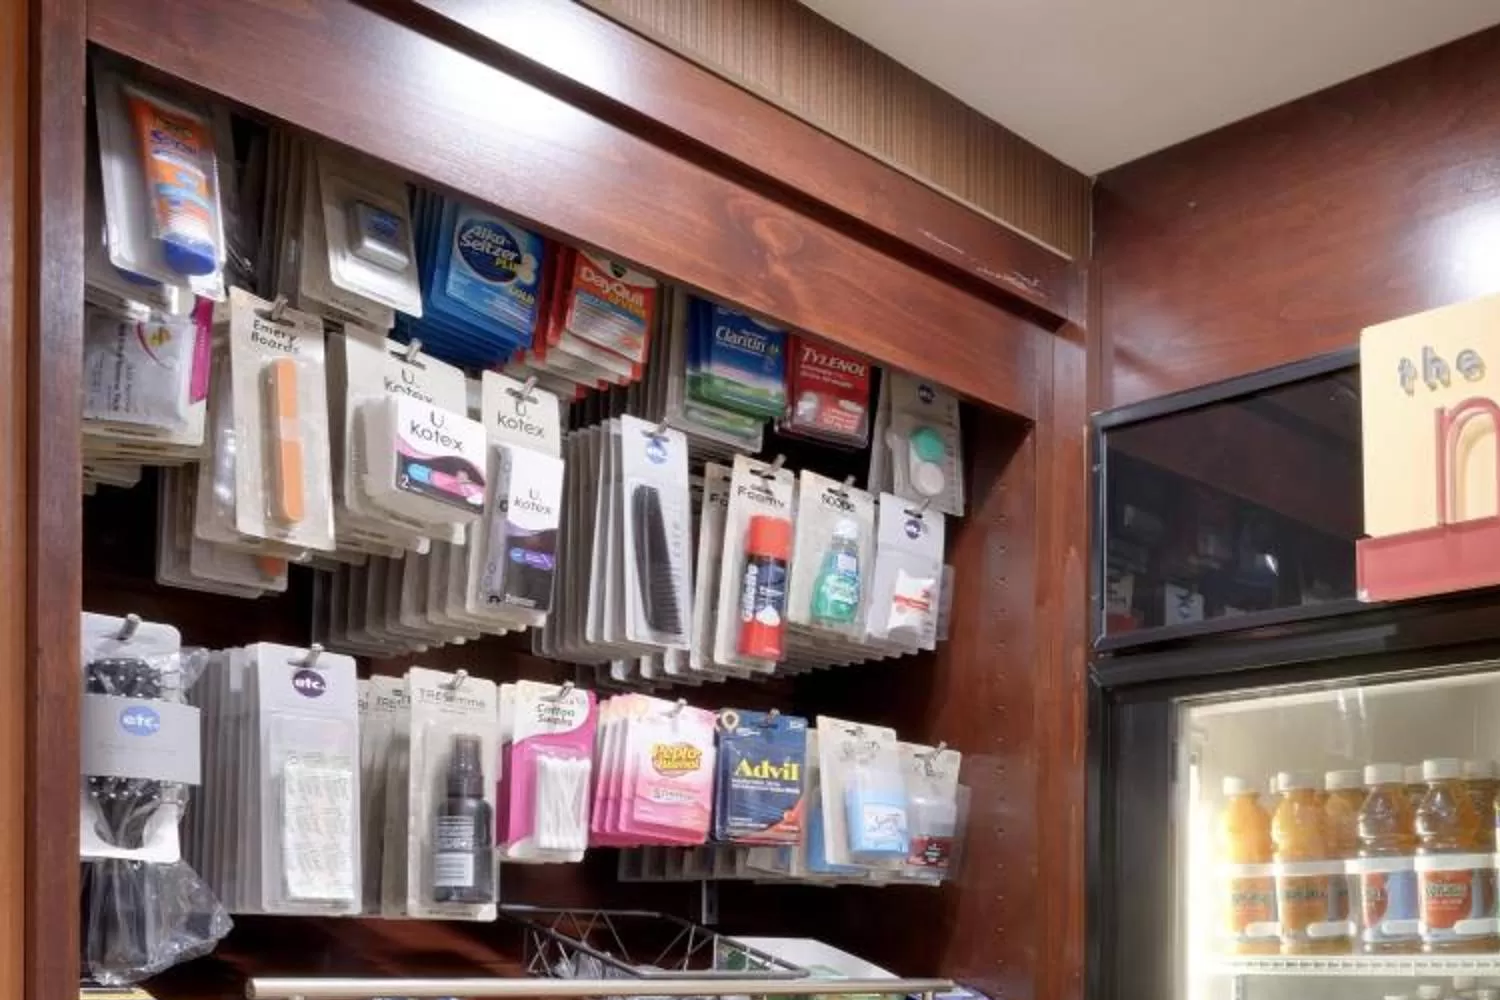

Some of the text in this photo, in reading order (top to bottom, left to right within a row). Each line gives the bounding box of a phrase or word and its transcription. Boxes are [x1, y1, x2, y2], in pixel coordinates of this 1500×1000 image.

[459, 234, 519, 259] Seltzer
[251, 331, 300, 353] Boards
[253, 319, 297, 341] Emery
[715, 326, 766, 353] Claritin
[802, 347, 865, 376] TYLENOL
[1398, 345, 1486, 396] the
[122, 712, 159, 732] etc.
[734, 756, 800, 781] Advil
